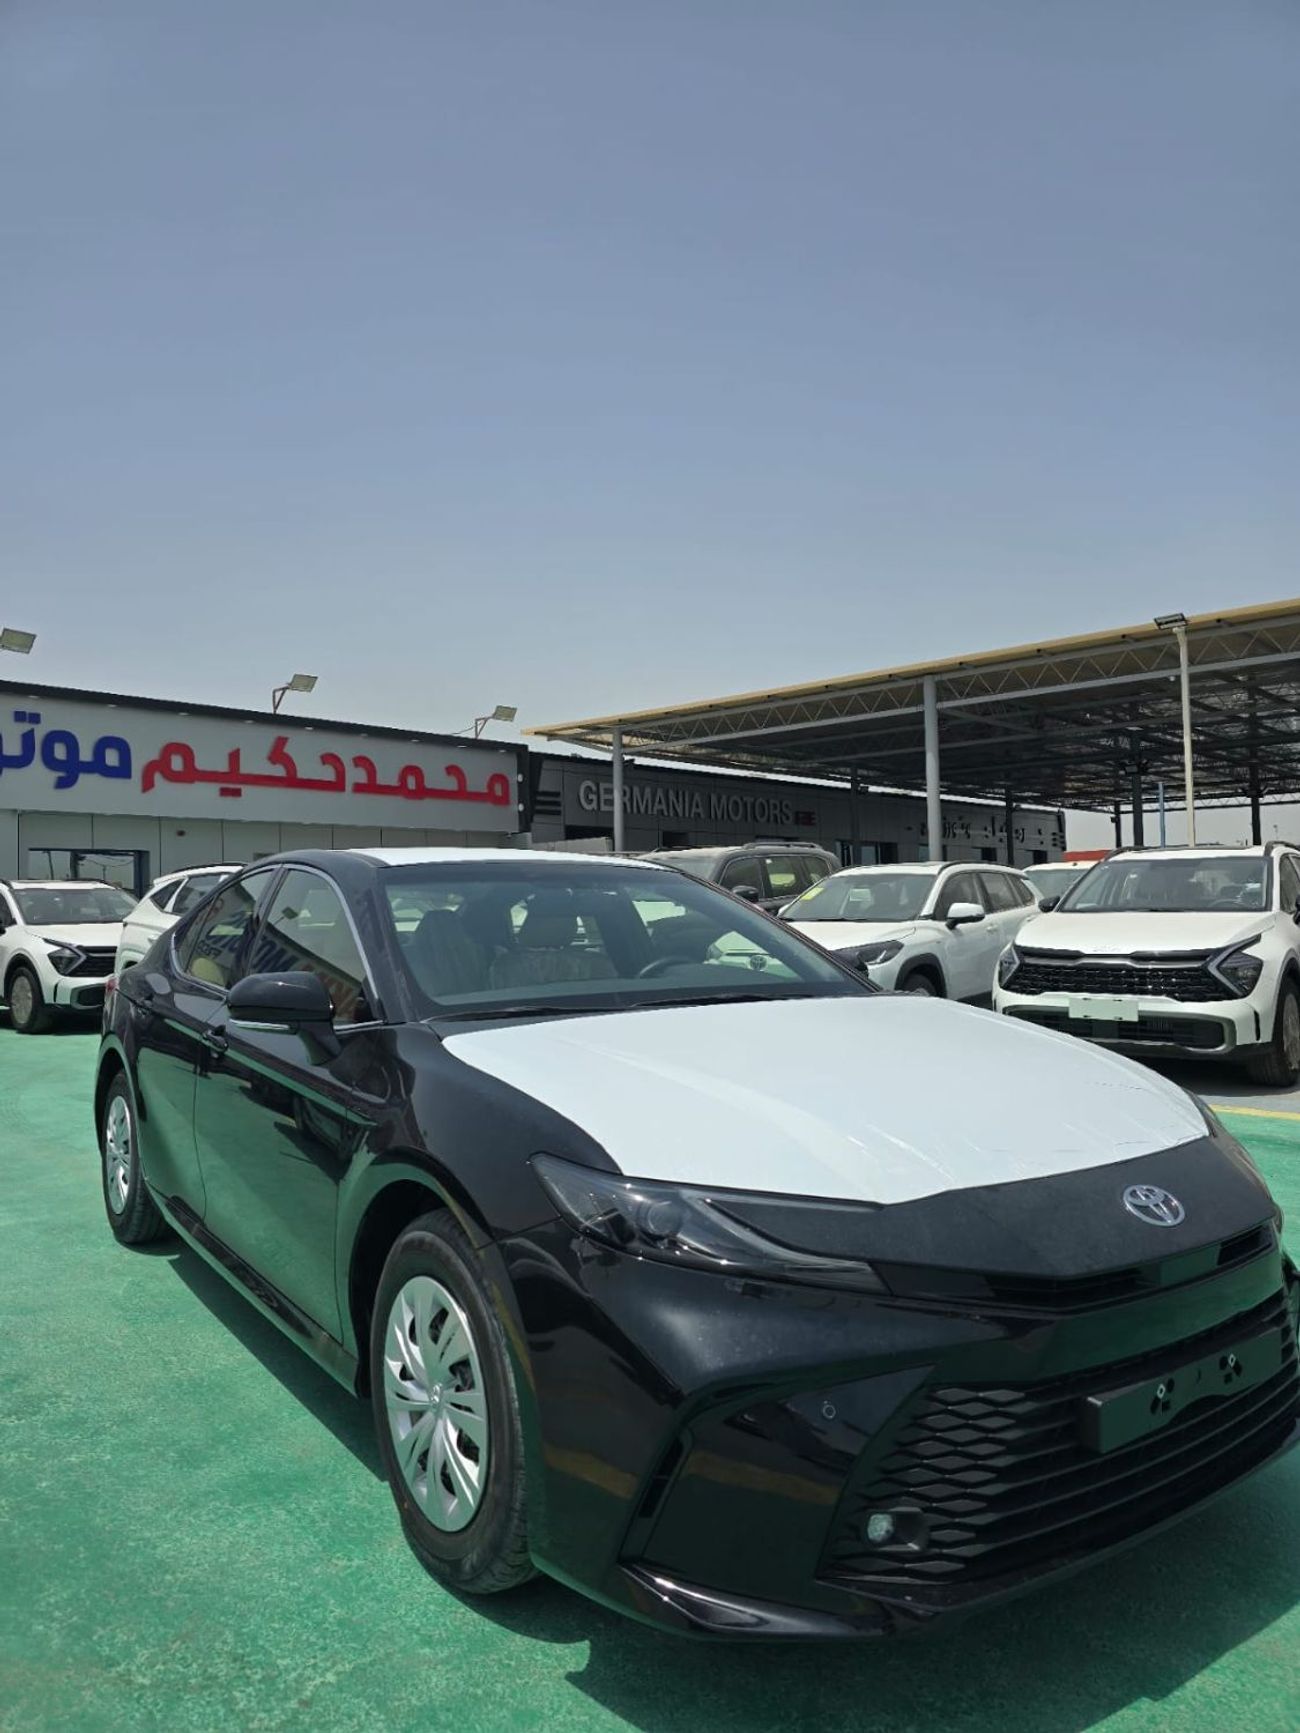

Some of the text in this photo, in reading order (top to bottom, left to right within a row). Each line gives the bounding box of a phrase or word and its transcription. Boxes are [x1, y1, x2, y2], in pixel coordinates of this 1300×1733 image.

[0, 711, 510, 805] محمد حكيم موت
[579, 780, 704, 817] GERMANIA
[710, 793, 793, 824] MOTORS
